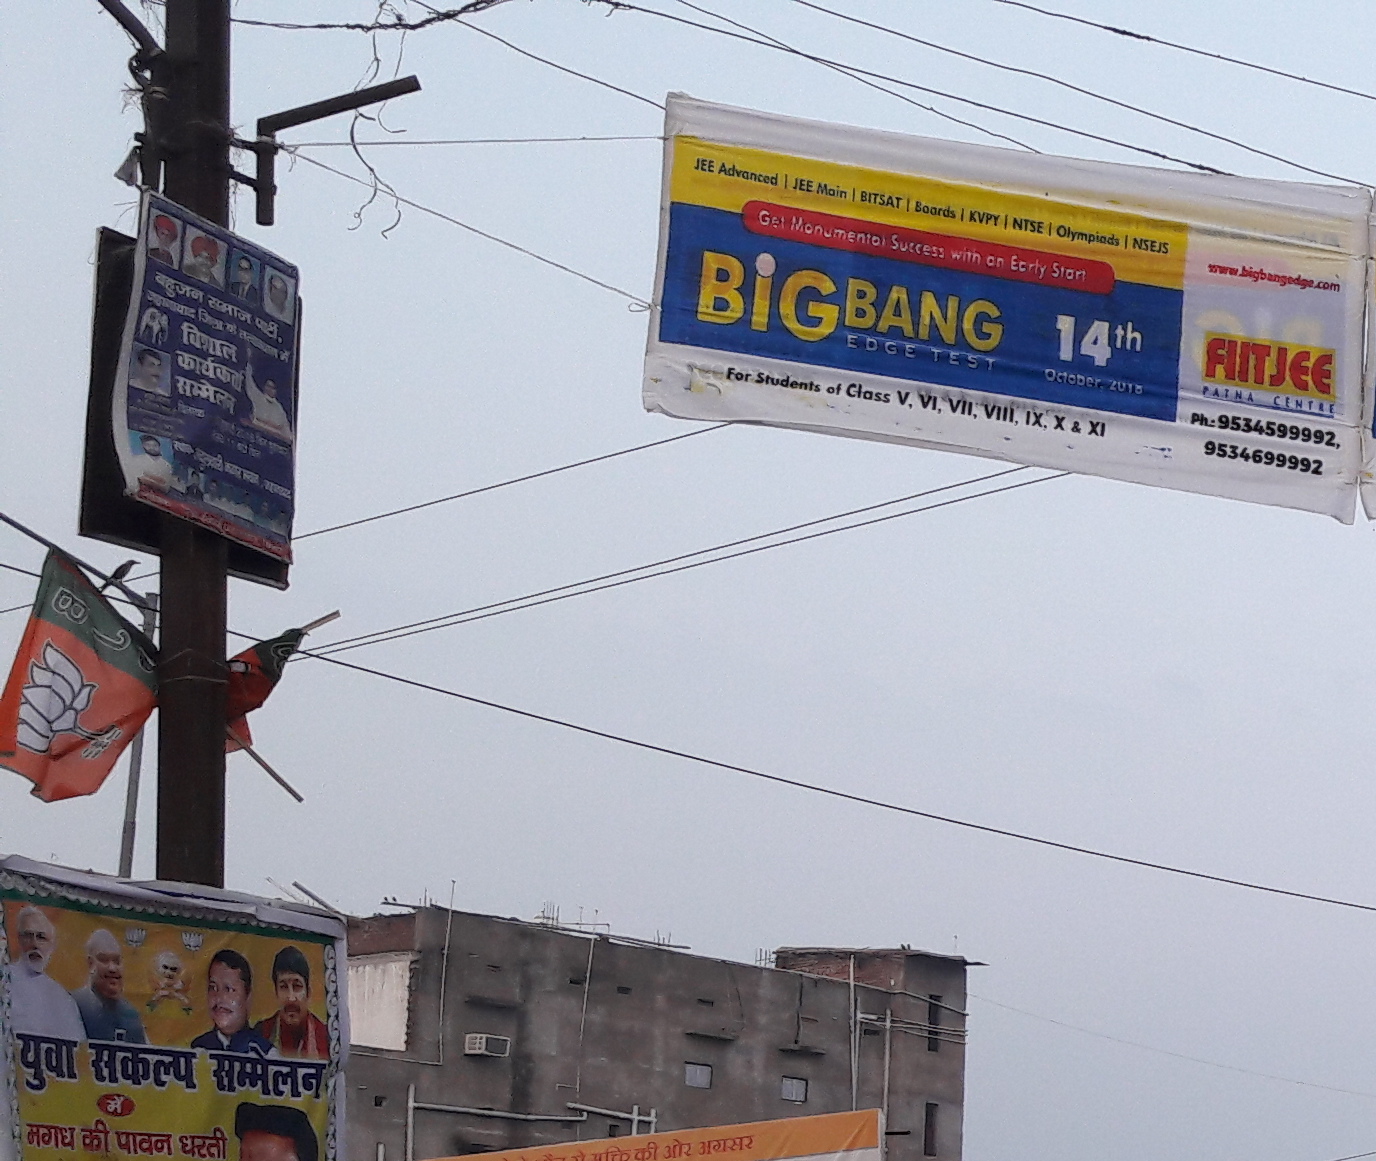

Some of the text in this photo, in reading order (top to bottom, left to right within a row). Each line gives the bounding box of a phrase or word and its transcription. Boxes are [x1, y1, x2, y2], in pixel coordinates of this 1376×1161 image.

[694, 158, 1169, 254] JEE Advanced JEE Main BITSAT Boards KVPY NTSE Olympiads NSEJS
[758, 210, 1087, 282] Get Monumental Success with an Early Start
[1207, 262, 1341, 293] www.bigbangedge.com
[846, 334, 997, 371] EDGE TEST
[1055, 313, 1143, 367] 14th
[1204, 337, 1333, 395] FIITJEE
[725, 367, 1107, 438] For Students of Class V, VI, VII, VIII, IX, X & XI
[1202, 386, 1335, 414] PATNA CENTRE
[1203, 440, 1324, 476] 9534699992
[16, 1033, 79, 1090] युवा
[209, 1047, 327, 1099] सम्मेलन
[106, 1096, 124, 1113] में
[26, 1118, 228, 1159] मगध की पावन धरती
[634, 1142, 658, 1161] की
[664, 1139, 692, 1159] ओर
